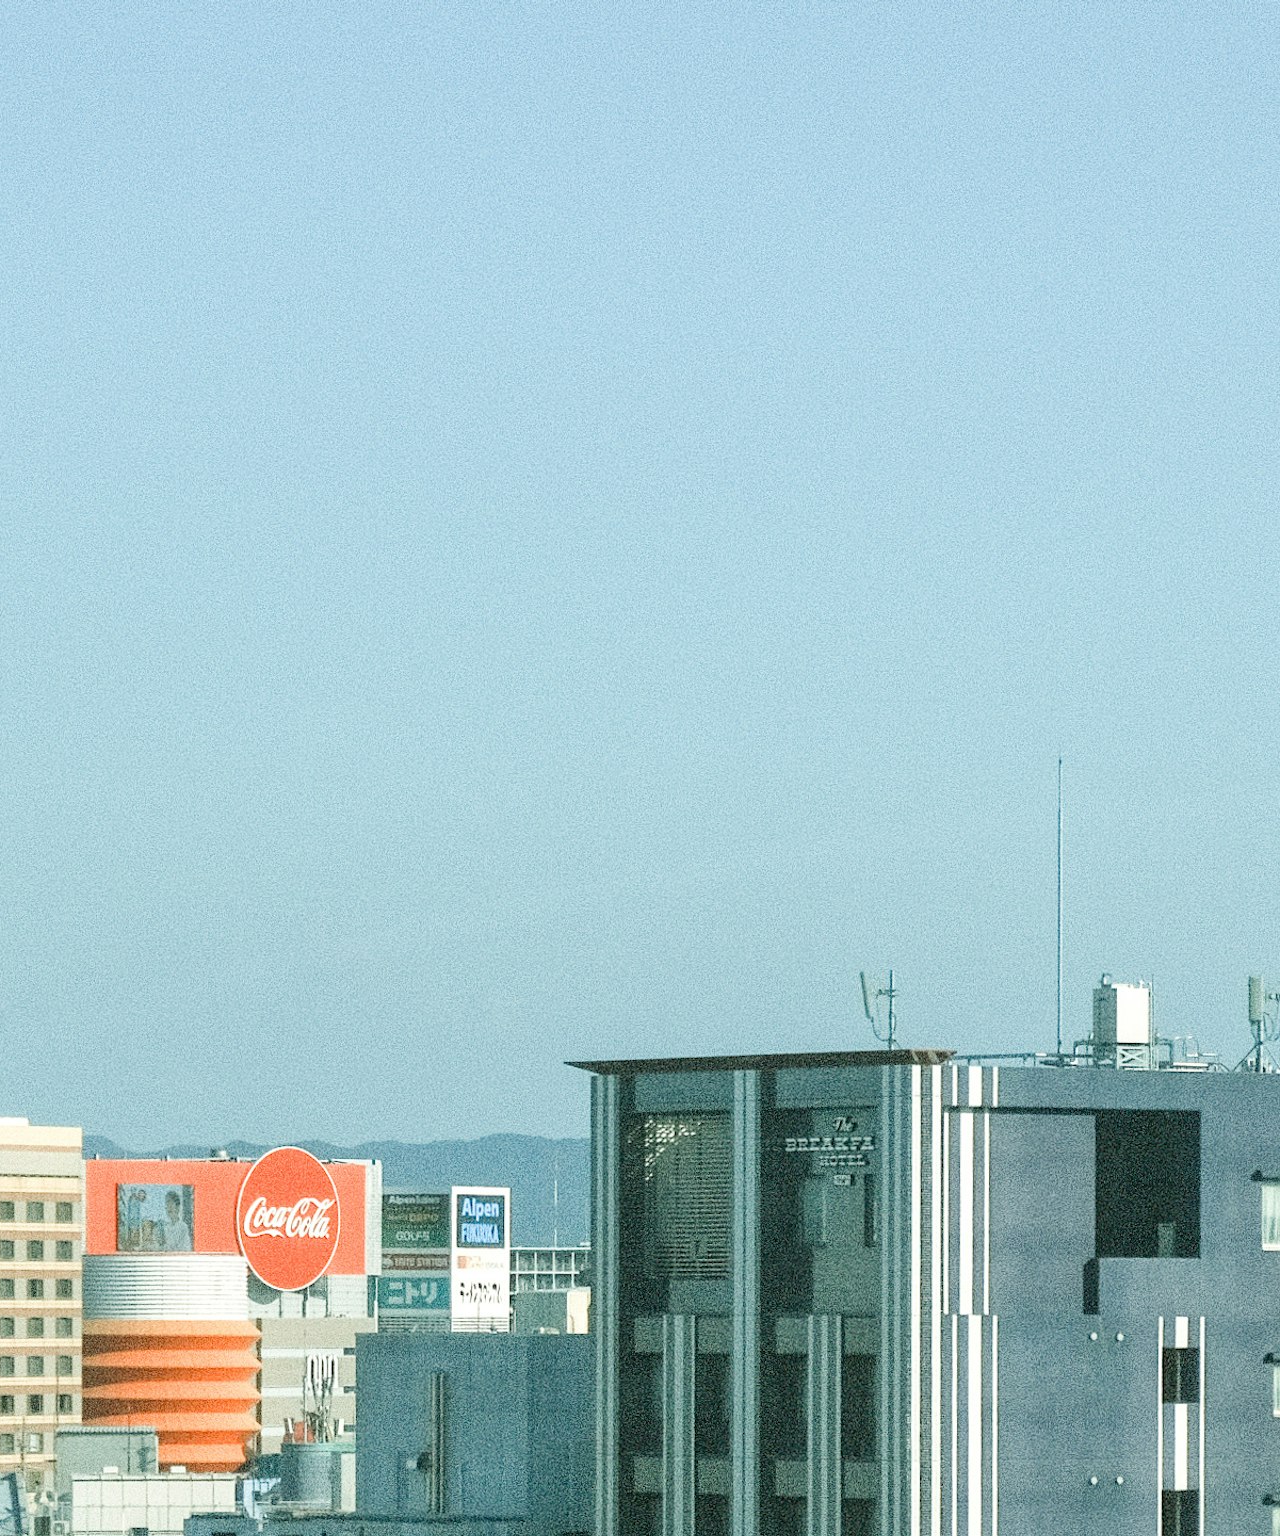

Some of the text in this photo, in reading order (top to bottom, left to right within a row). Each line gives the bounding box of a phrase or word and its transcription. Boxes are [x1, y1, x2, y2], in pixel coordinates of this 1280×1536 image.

[819, 1155, 866, 1166] HOTEL
[244, 1197, 335, 1239] Coca-Cola
[462, 1198, 500, 1221] Alpen
[388, 1282, 438, 1304] ニトリ
